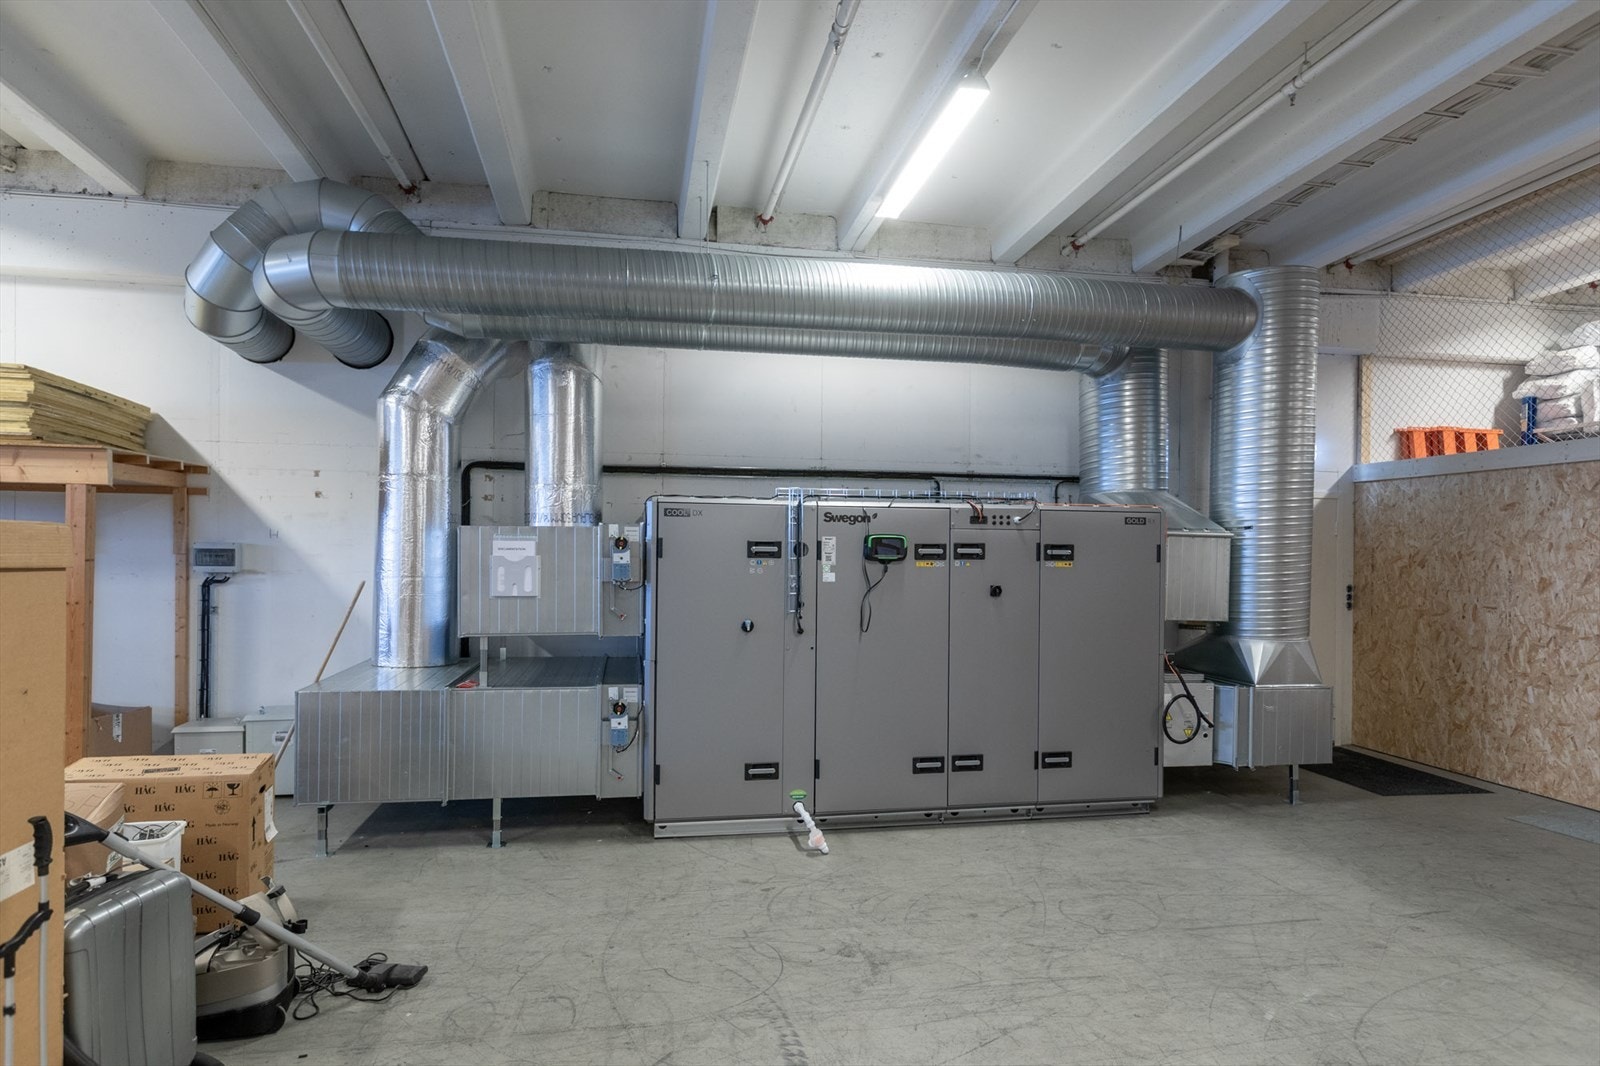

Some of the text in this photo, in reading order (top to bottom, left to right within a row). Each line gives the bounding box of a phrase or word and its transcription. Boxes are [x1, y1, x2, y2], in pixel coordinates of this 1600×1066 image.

[823, 512, 871, 525] Swegon
[135, 784, 156, 795] HÅG
[175, 784, 196, 794] HÅG
[123, 804, 136, 813] ÅG
[154, 803, 175, 812] HÅG
[196, 836, 217, 846] HÅG
[182, 854, 195, 864] ÅG
[219, 851, 239, 862] HÅG
[196, 870, 217, 880] HÅG
[196, 905, 217, 915] HÅG
